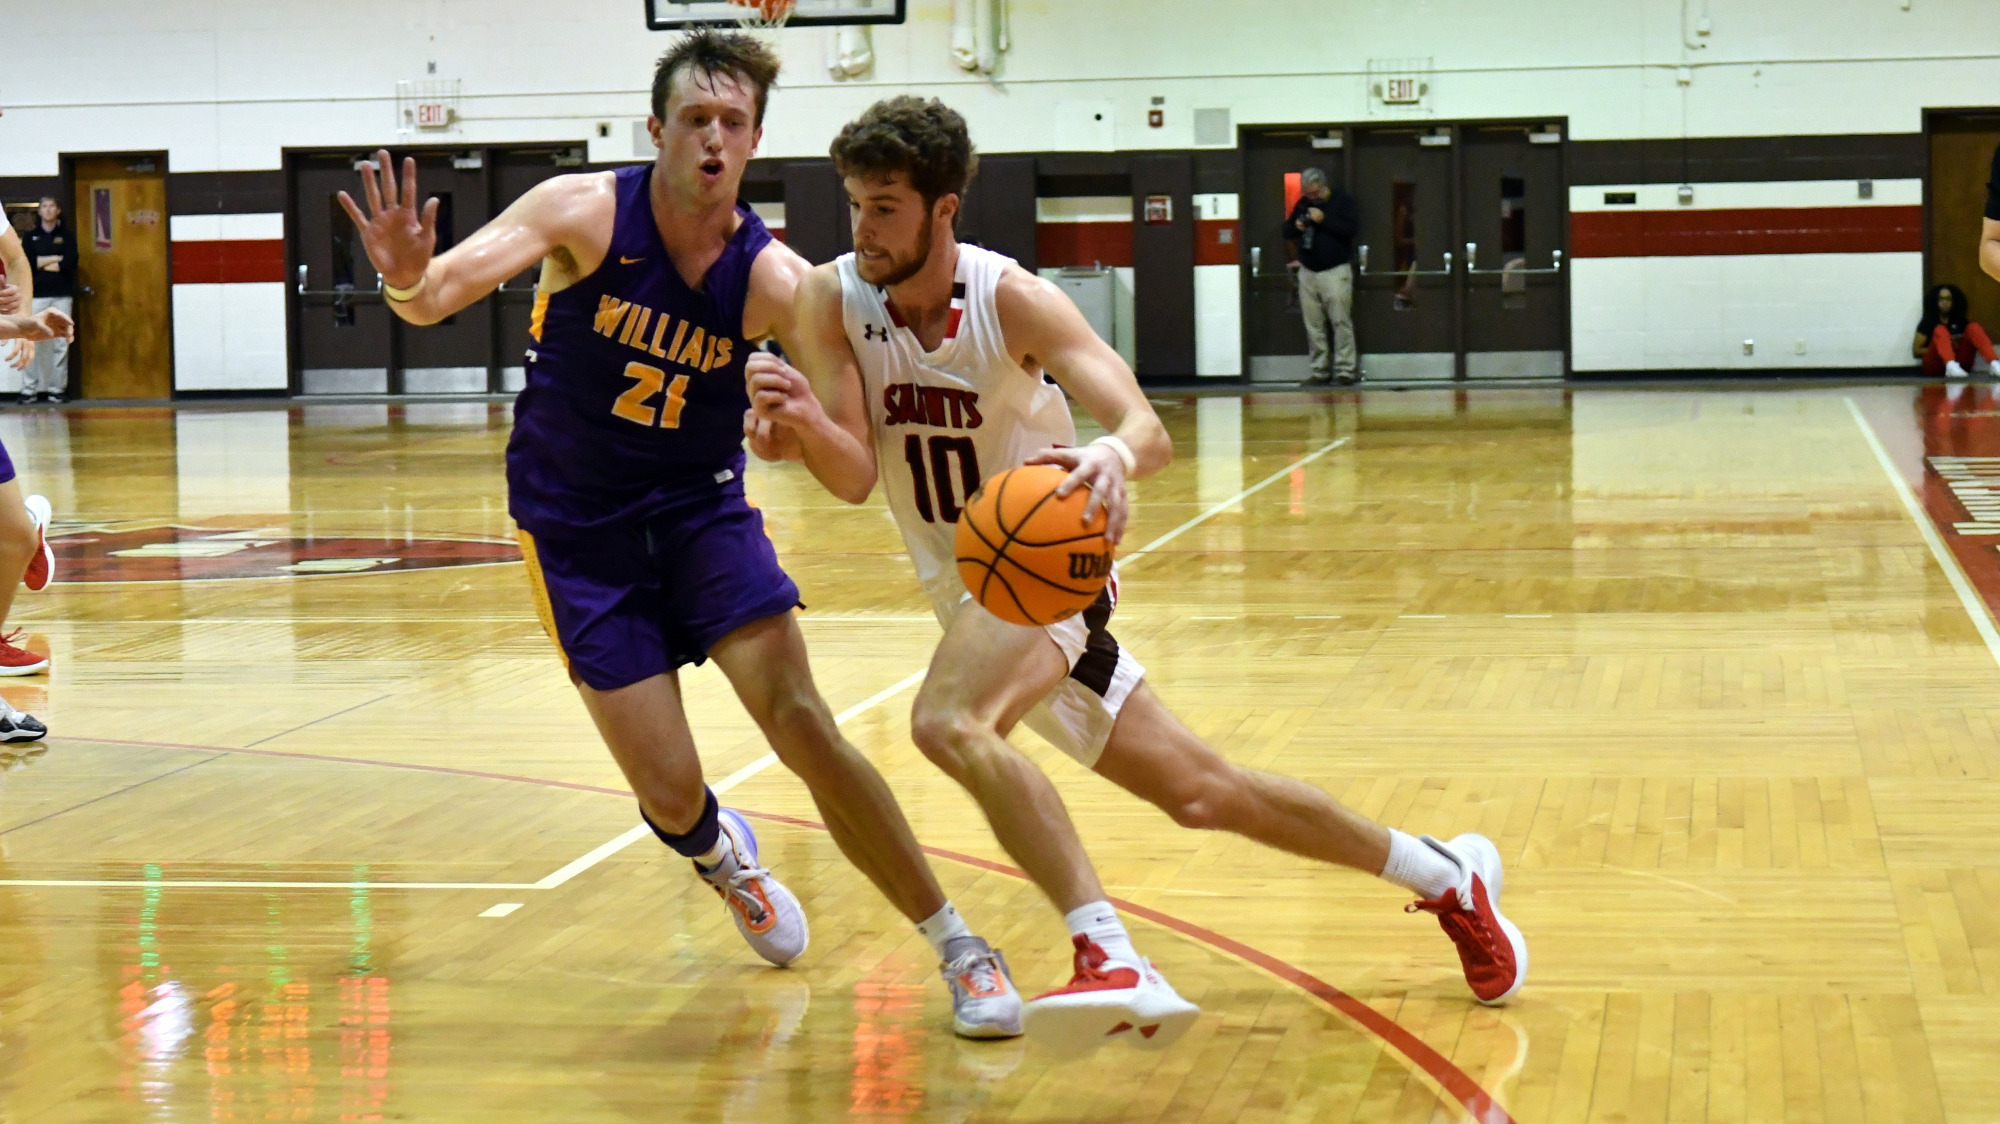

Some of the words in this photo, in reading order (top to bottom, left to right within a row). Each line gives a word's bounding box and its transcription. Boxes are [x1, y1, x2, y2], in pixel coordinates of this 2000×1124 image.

[1388, 79, 1414, 98] EXIT
[419, 104, 442, 122] EXIT
[611, 361, 690, 429] 21
[904, 434, 981, 523] 10
